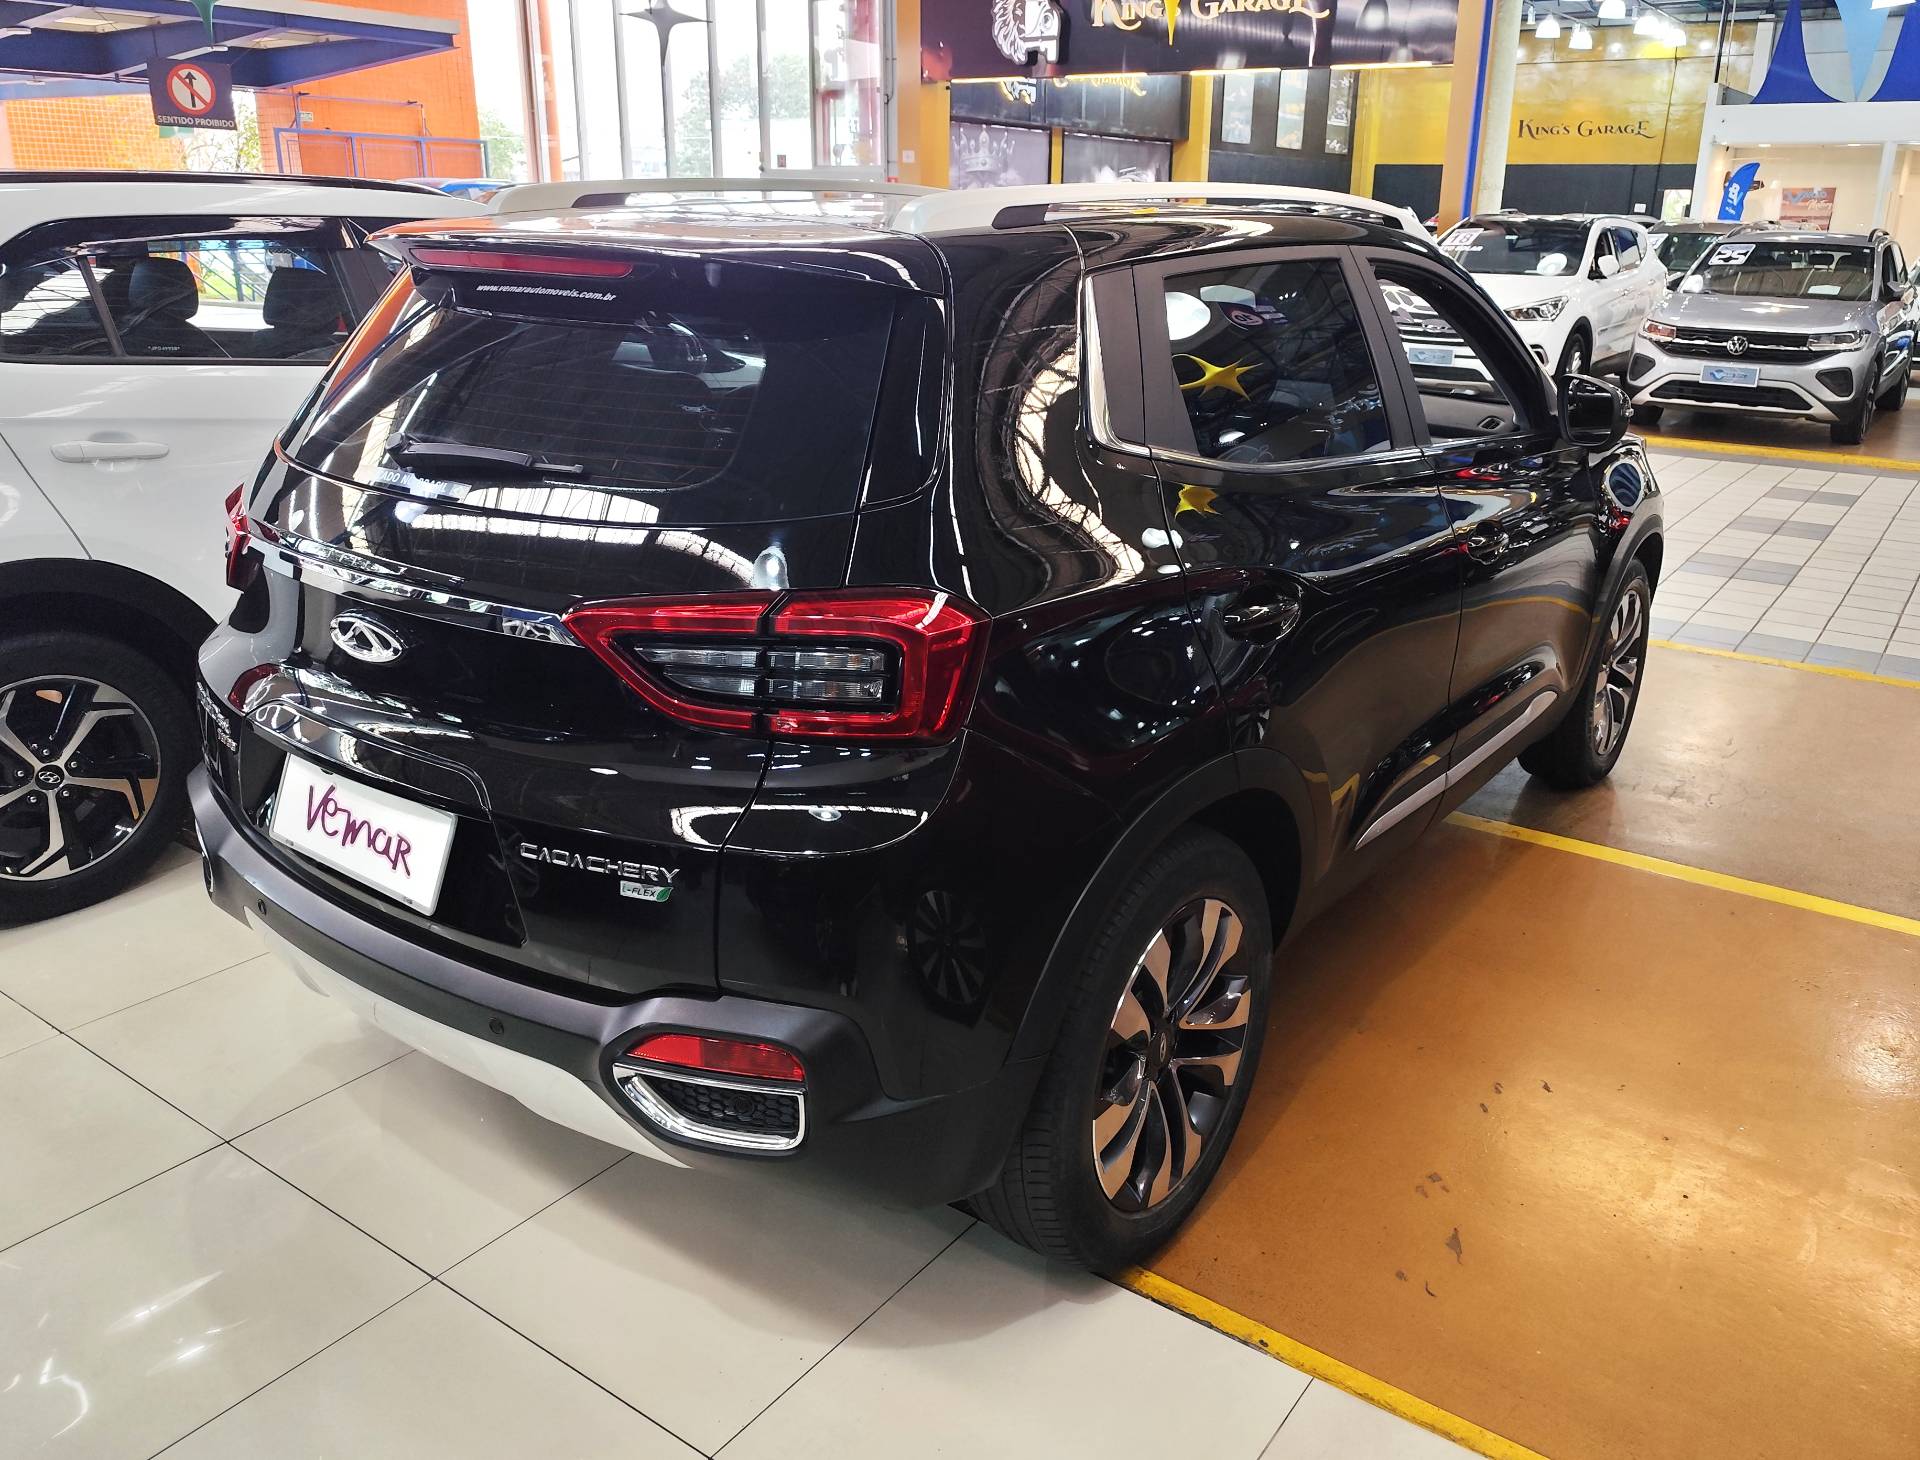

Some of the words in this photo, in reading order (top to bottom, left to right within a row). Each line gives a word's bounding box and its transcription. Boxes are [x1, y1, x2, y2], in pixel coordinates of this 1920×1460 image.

[157, 115, 194, 125] SENTIDO
[195, 118, 235, 128] PROIBIDO
[1518, 119, 1570, 140] KING'S
[1577, 120, 1656, 139] GARAGE
[1711, 249, 1749, 264] 25
[476, 285, 617, 301] www.vemarautomoveis.com.br
